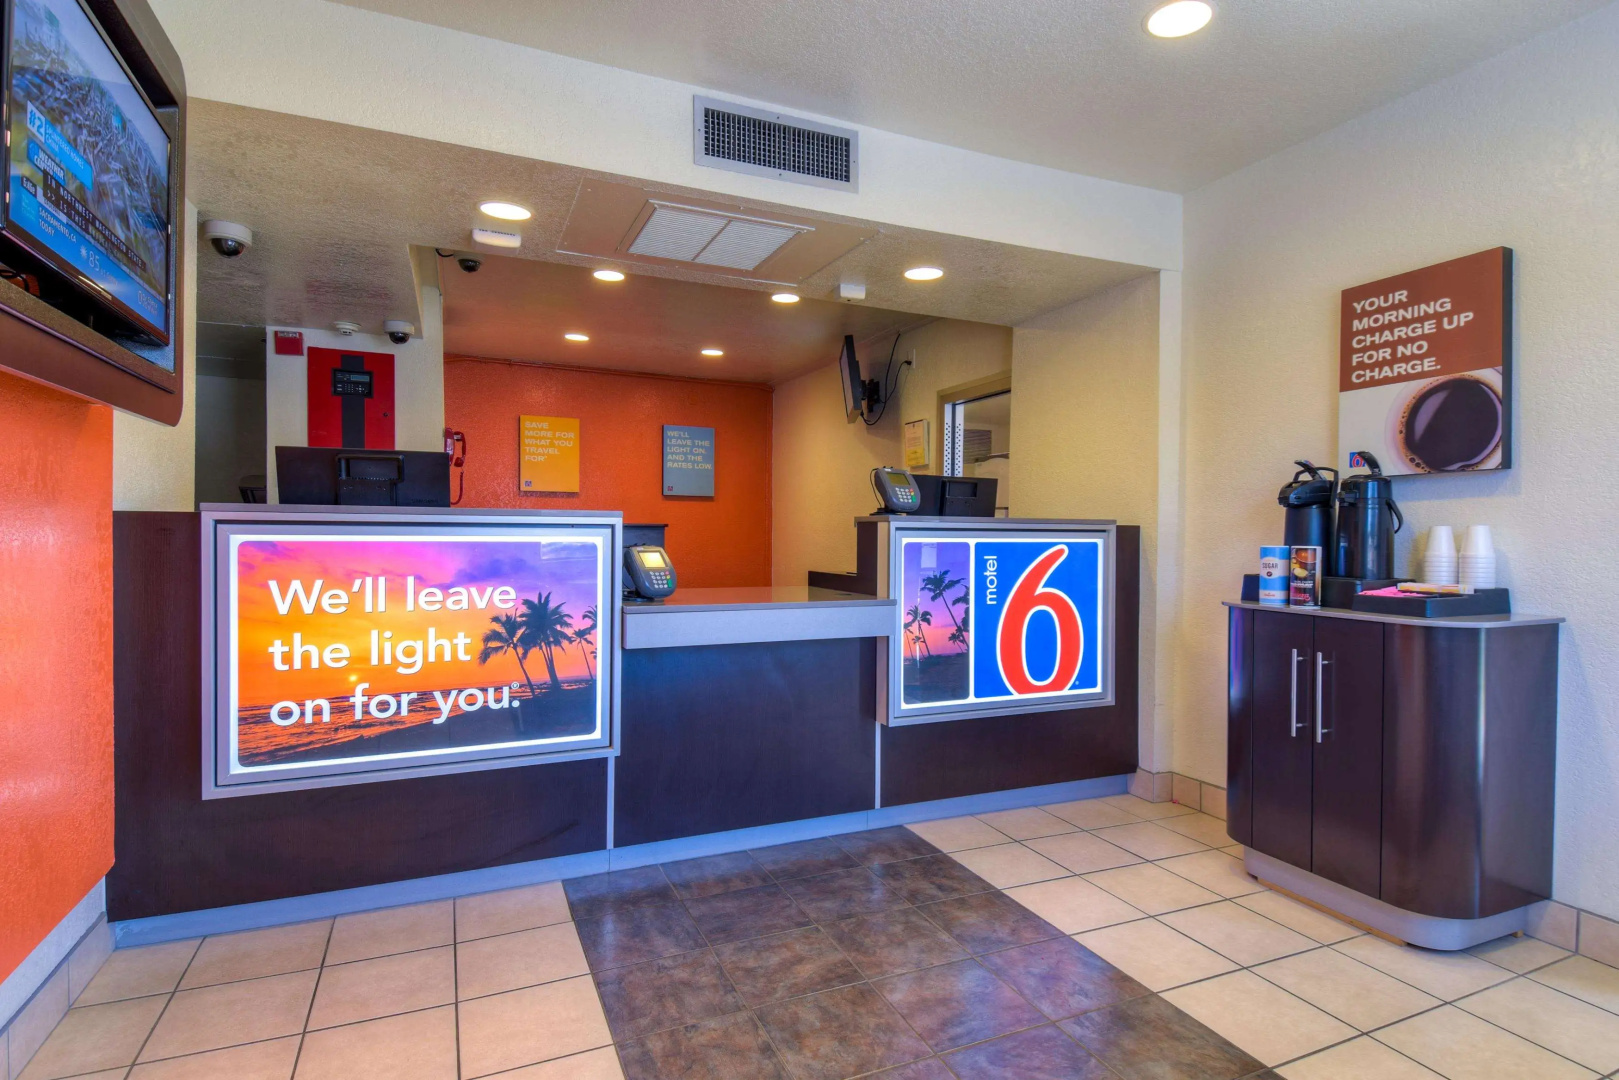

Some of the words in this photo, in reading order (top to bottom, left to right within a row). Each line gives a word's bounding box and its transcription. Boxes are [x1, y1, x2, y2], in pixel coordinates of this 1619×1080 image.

[29, 109, 44, 138] #2
[39, 148, 64, 181] WEATHER
[60, 186, 93, 222] NORTHWEST
[39, 218, 55, 237] TODAY
[88, 250, 100, 272] 85
[1352, 290, 1408, 314] YOUR
[1352, 298, 1452, 332] MORNING
[1352, 319, 1437, 349] CHARGE
[1442, 311, 1474, 329] UP
[1352, 347, 1392, 366] FOR
[1397, 340, 1428, 358] NO
[1351, 357, 1442, 384] CHARGE.
[525, 421, 549, 429] SAVE
[525, 430, 553, 438] MORE
[525, 438, 551, 446] WHAT
[525, 446, 560, 454] TRAVEL
[407, 576, 517, 612] leave
[984, 555, 998, 605] motel
[996, 544, 1084, 695] 6
[268, 632, 351, 671] the
[371, 627, 471, 675] light
[270, 699, 330, 726] on
[350, 682, 418, 720] for
